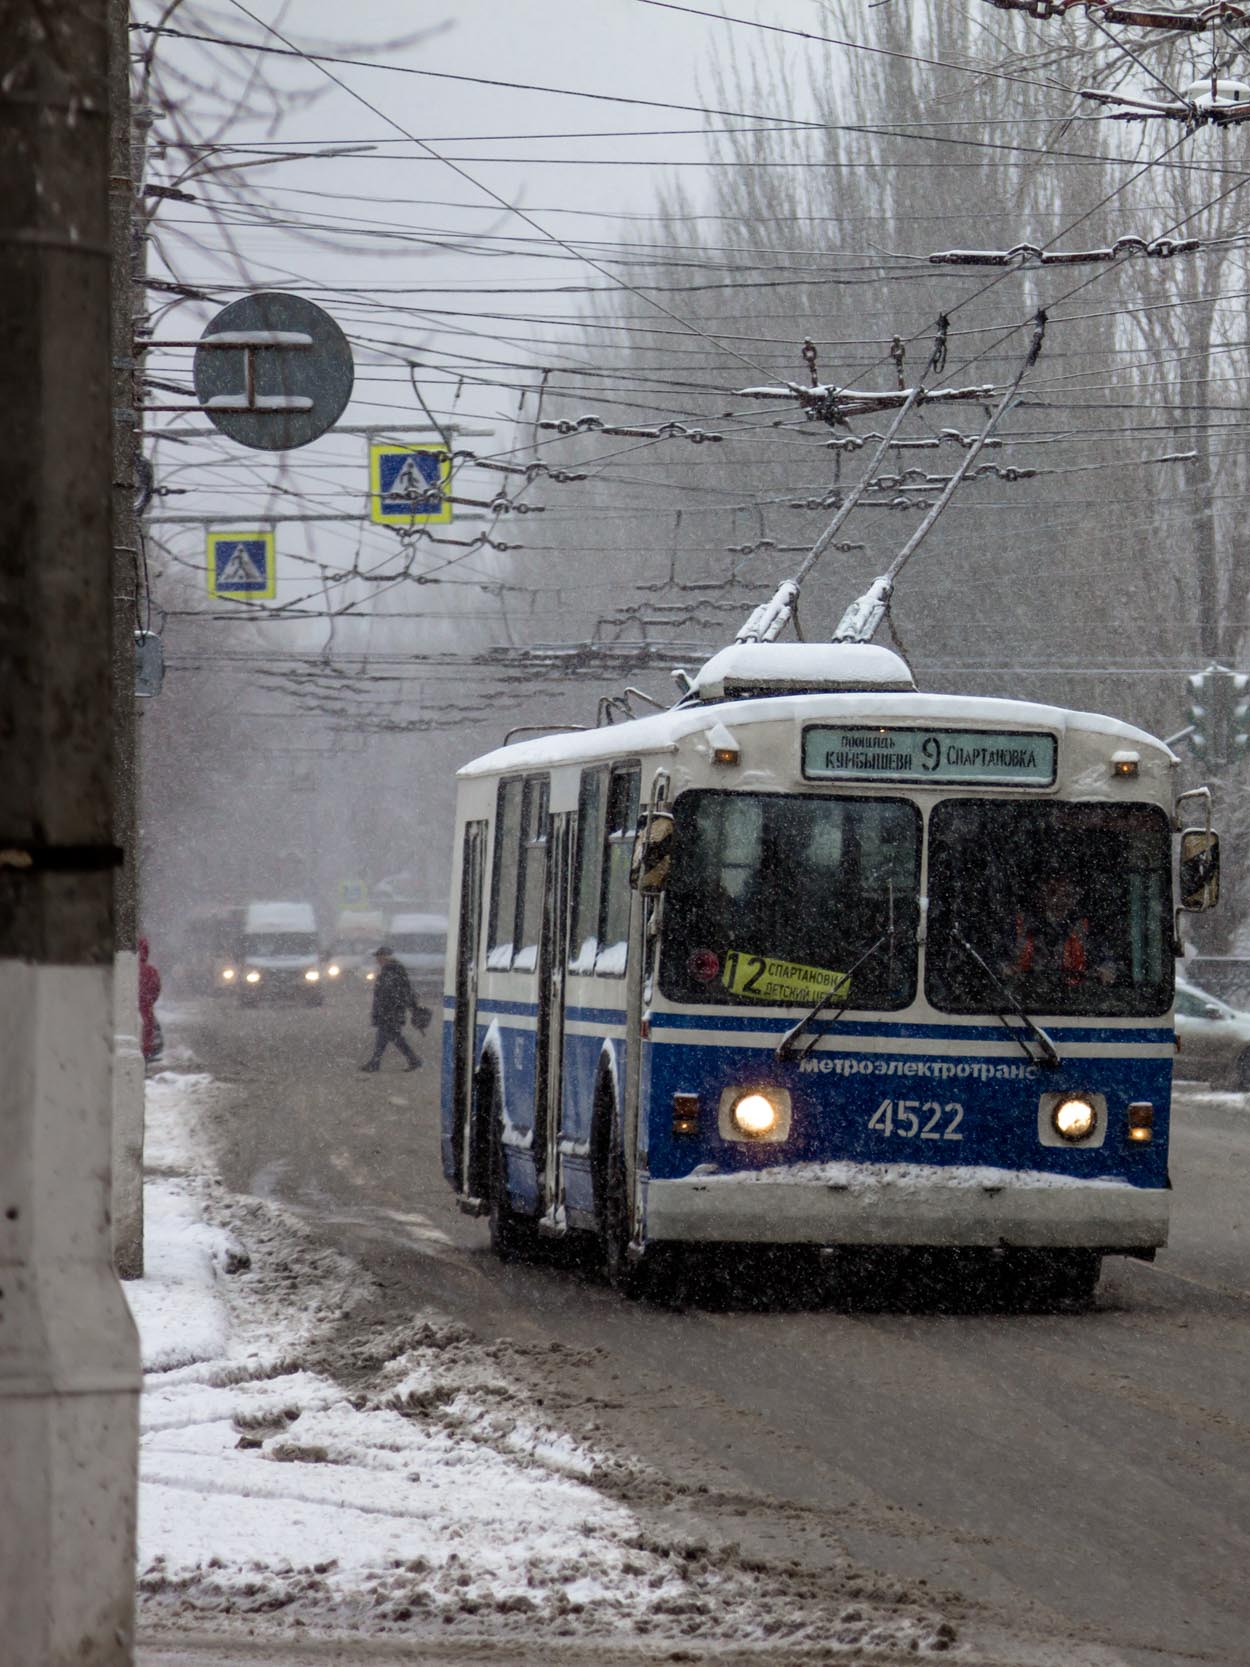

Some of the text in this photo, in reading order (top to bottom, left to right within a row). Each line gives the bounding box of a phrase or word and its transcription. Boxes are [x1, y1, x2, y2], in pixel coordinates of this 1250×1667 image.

[921, 737, 942, 772] 9
[946, 745, 1037, 768] СПАРТАНОВКА
[726, 952, 767, 995] 12
[799, 1058, 1039, 1081] метроэлектротранс
[868, 1099, 964, 1141] 4522
